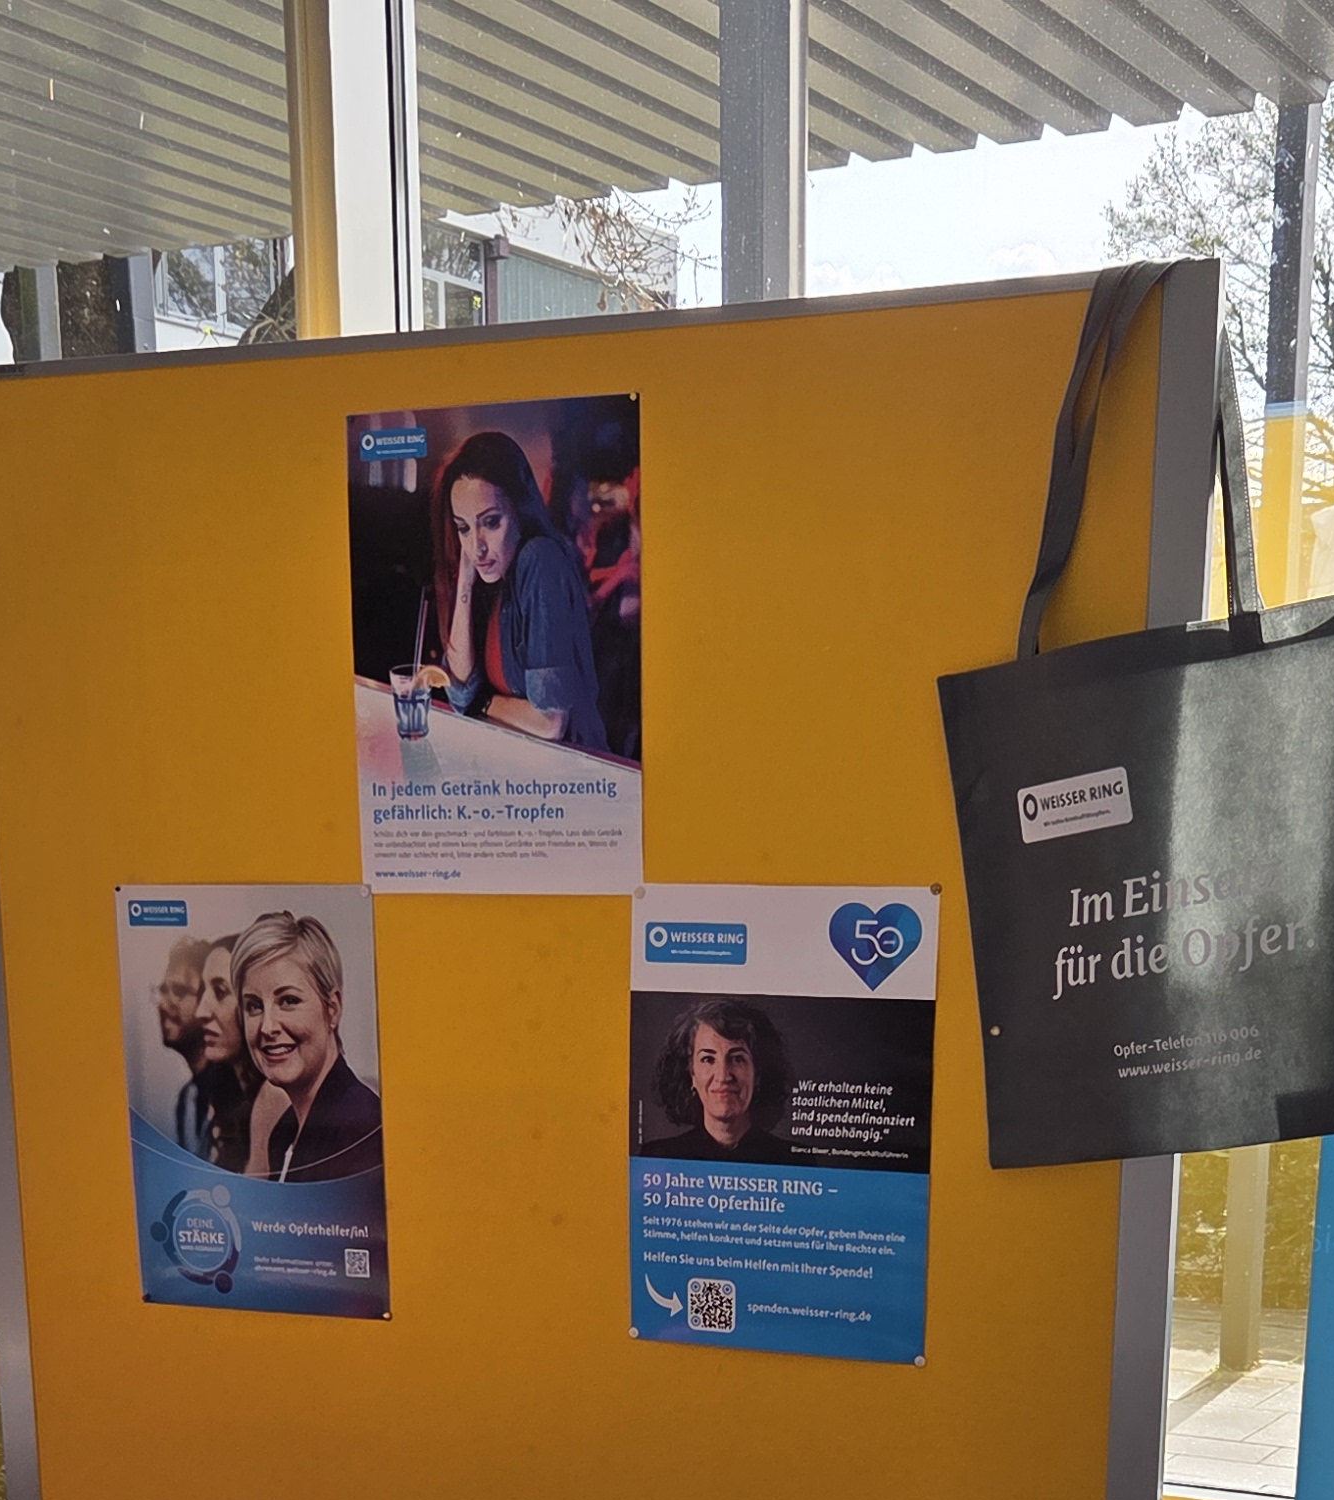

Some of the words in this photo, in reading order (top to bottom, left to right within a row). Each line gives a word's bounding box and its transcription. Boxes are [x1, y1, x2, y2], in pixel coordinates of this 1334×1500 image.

[372, 782, 387, 796] In
[391, 781, 436, 800] jedem
[441, 779, 501, 796] Getränk
[506, 778, 617, 798] hochprozentig
[1039, 789, 1087, 812] WEISSER
[1089, 780, 1124, 802] RING
[373, 805, 452, 824] gefährlich:
[457, 803, 564, 823] K.-o.-Tropfen
[375, 869, 461, 880] www.weisser-ring.de
[1069, 888, 1114, 927] Im
[671, 931, 715, 943] WEISSER
[717, 933, 744, 945] RING
[1052, 945, 1102, 1000] für
[1111, 935, 1168, 980] die
[1113, 1035, 1203, 1059] Opfer-Telefon
[818, 1082, 862, 1095] erhalten
[864, 1083, 893, 1095] keine
[792, 1096, 849, 1108] staatlichen
[851, 1098, 886, 1112] Mittel,
[792, 1110, 814, 1122] sind
[816, 1111, 915, 1127] spendenfinanziert
[791, 1125, 812, 1136] und
[643, 1173, 661, 1186] 50
[665, 1174, 705, 1190] Jahre
[708, 1175, 778, 1192] WEISSER
[782, 1179, 823, 1196] RING
[643, 1192, 661, 1206] 50
[665, 1193, 705, 1209] Jahre
[708, 1195, 785, 1213] Opferhilfe
[252, 1221, 286, 1234] Werde
[288, 1221, 369, 1240] Opferhelfer/in!
[747, 1301, 872, 1322] spenden.weisser-ring.de
